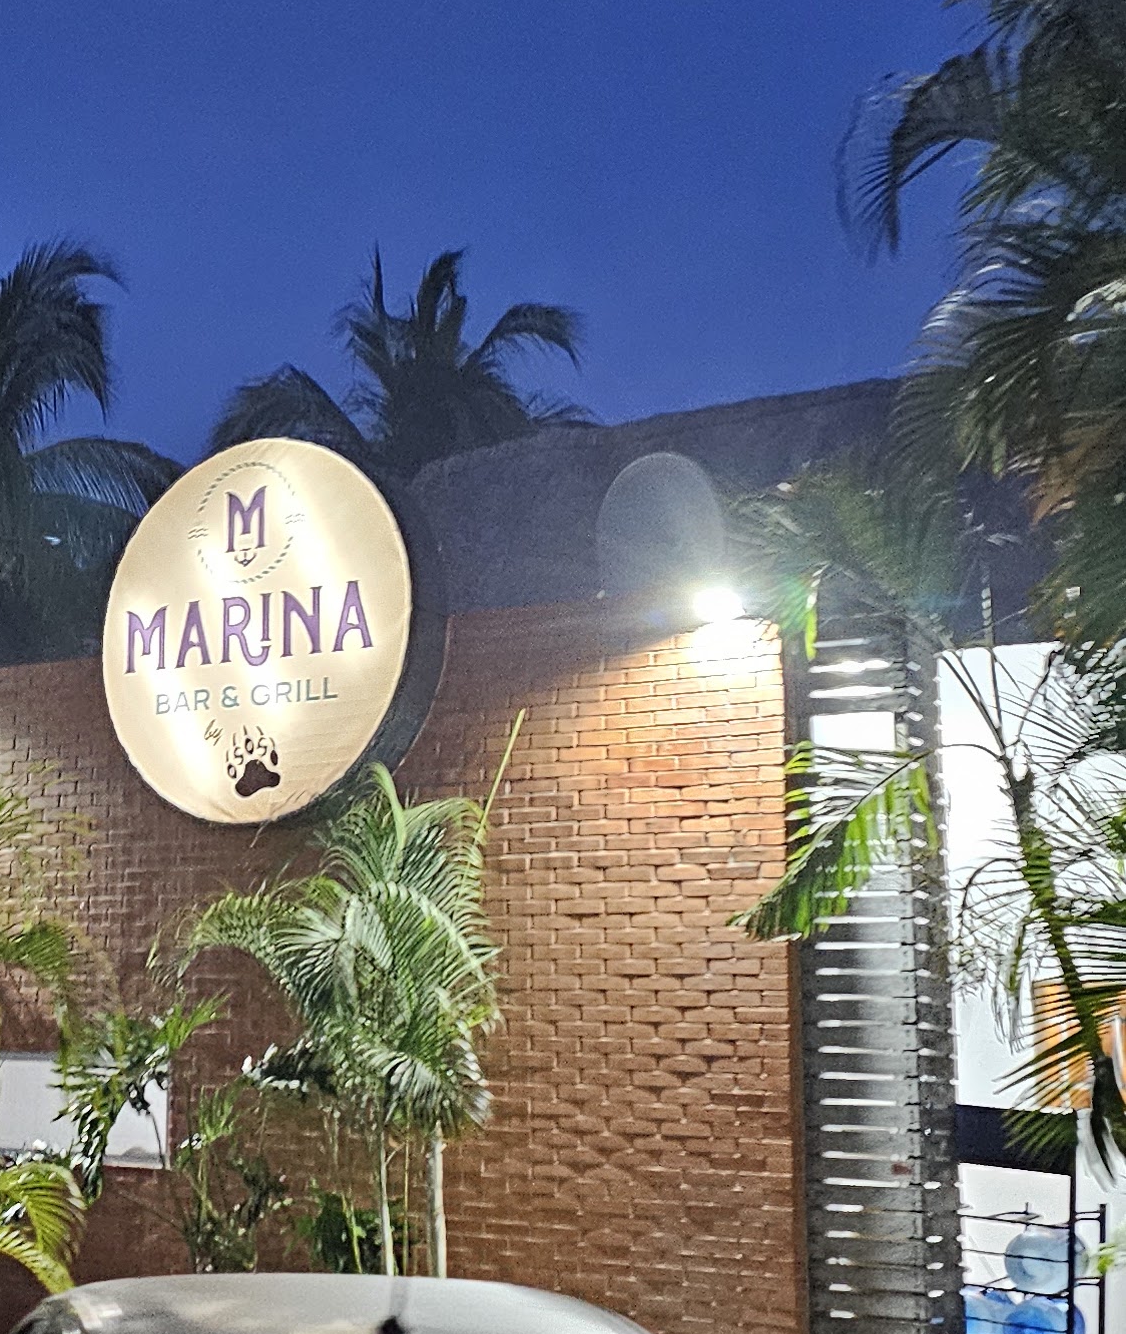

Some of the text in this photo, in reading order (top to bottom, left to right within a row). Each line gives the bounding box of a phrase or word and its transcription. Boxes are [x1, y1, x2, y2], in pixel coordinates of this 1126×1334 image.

[225, 485, 268, 553] M
[124, 581, 373, 674] MARINA
[155, 676, 339, 716] BAR & GRILL
[204, 718, 224, 747] by
